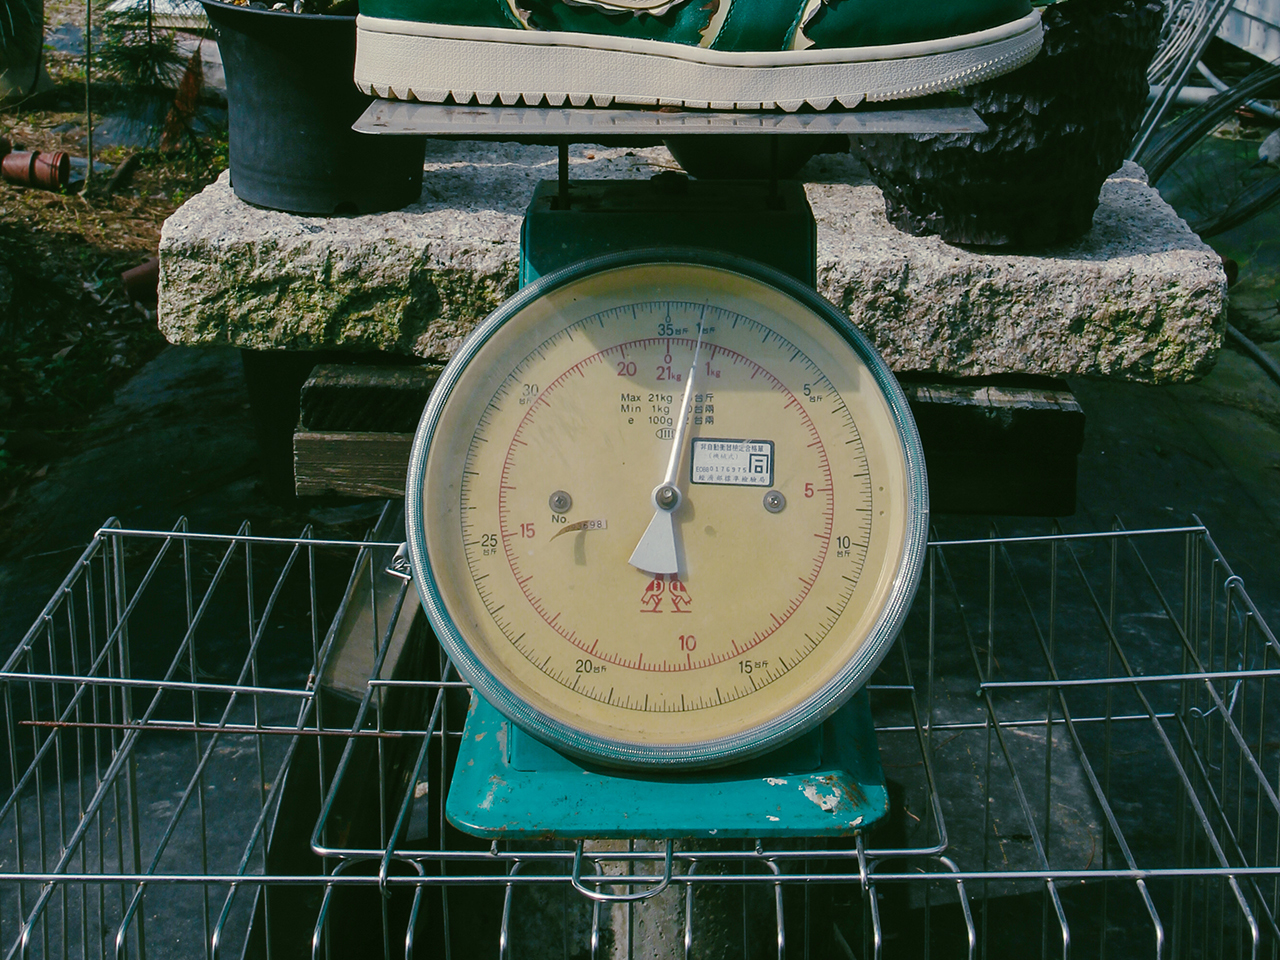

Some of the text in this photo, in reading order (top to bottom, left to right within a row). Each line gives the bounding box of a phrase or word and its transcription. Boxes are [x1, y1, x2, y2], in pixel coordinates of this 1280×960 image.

[664, 354, 673, 364] 0
[617, 361, 637, 376] 20
[656, 366, 682, 382] 21kg
[705, 361, 721, 378] 1kg
[522, 383, 539, 397] 30
[803, 383, 812, 396] 5
[621, 393, 641, 402] Max
[648, 393, 673, 404] 21kg
[621, 404, 641, 413] Min
[652, 404, 670, 415] 1kg
[628, 417, 635, 425] e
[648, 415, 673, 427] 100g
[804, 483, 814, 498] 5
[551, 515, 570, 524] No.
[520, 523, 535, 538] 15
[481, 534, 498, 547] 25
[836, 536, 851, 549] 10
[678, 635, 697, 651] 10
